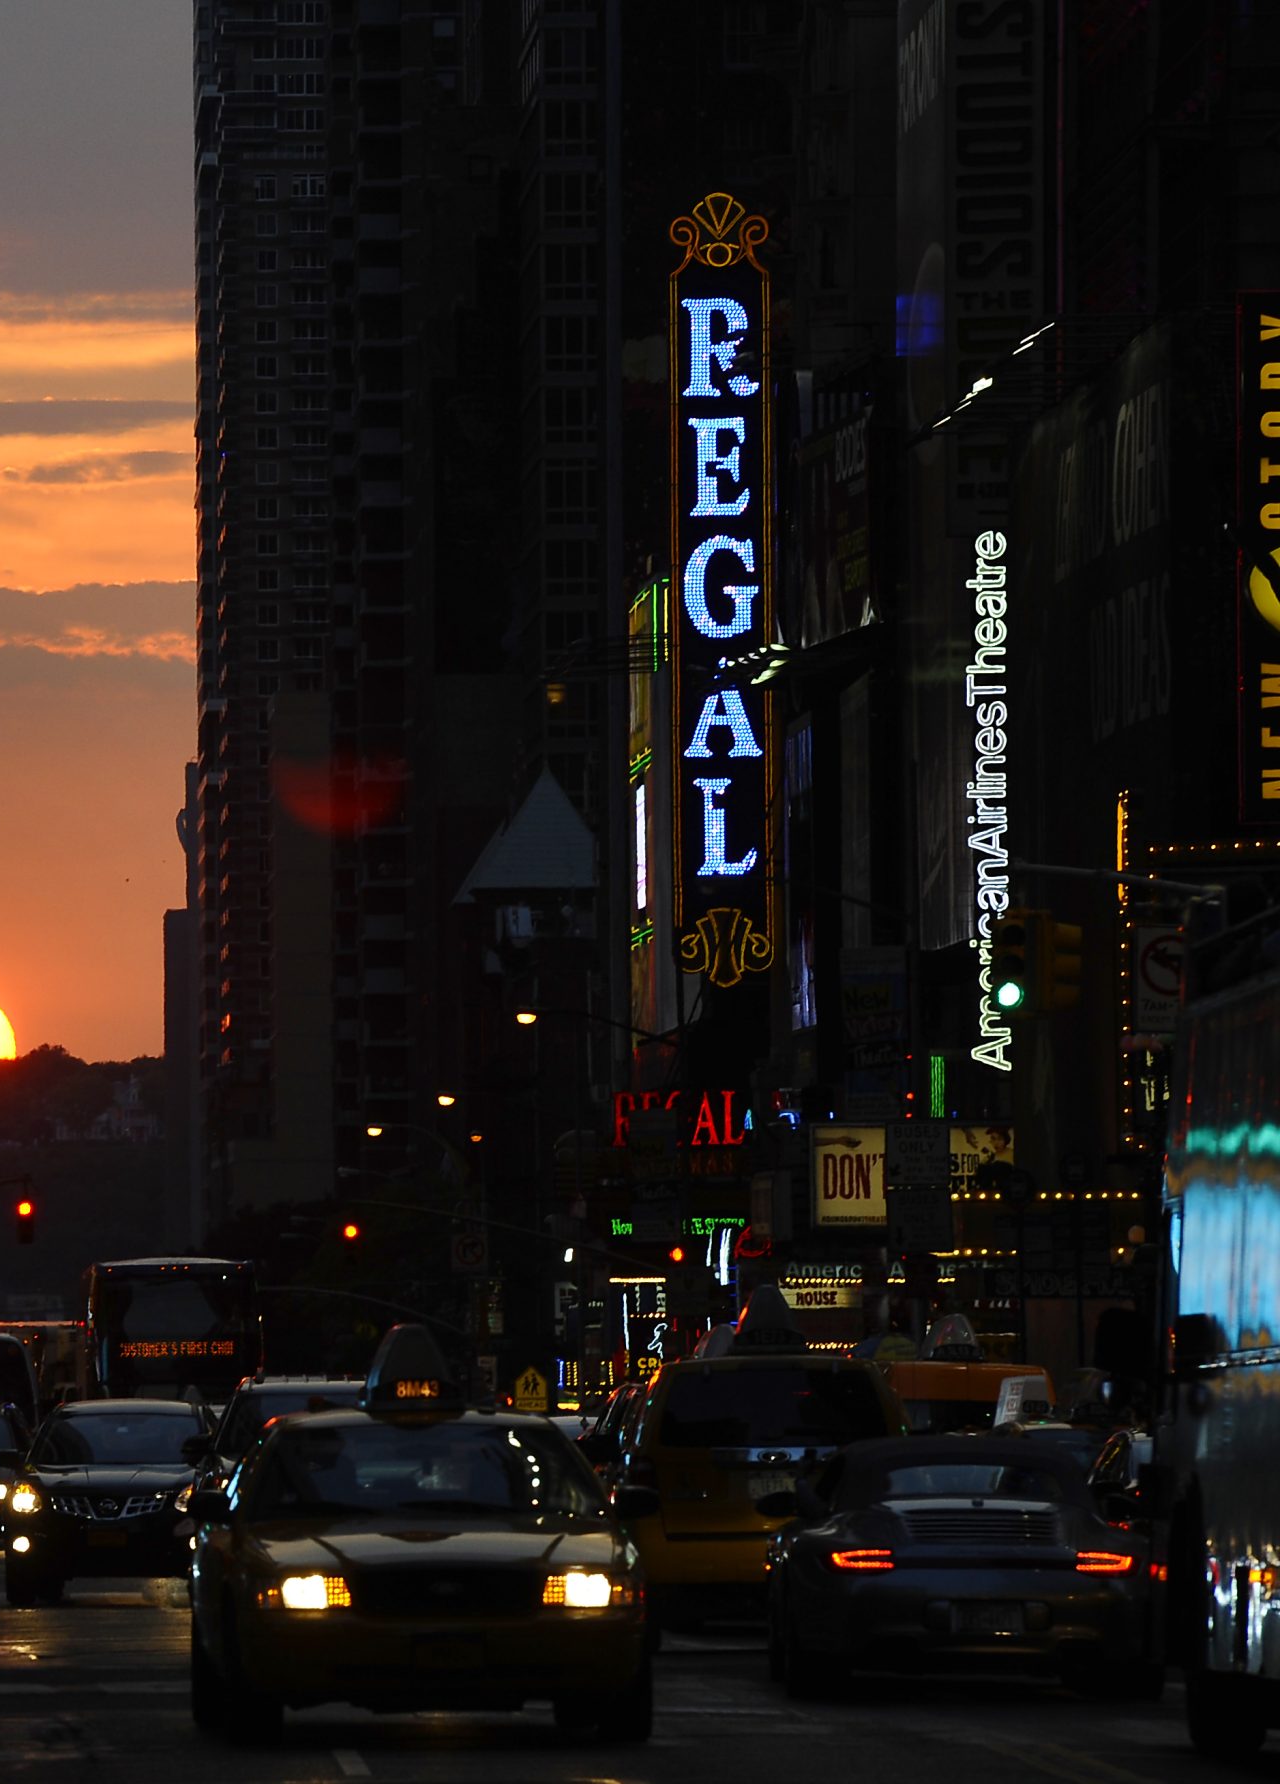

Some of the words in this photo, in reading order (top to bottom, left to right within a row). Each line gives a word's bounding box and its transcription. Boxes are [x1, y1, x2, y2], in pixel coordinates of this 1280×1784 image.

[677, 296, 763, 877] REGAL
[894, 1125, 941, 1139] BUSES
[899, 1140, 935, 1154] ONLY
[795, 1290, 838, 1306] HOUSE
[180, 1340, 209, 1357] FIRST
[396, 1379, 441, 1399] 8M43
